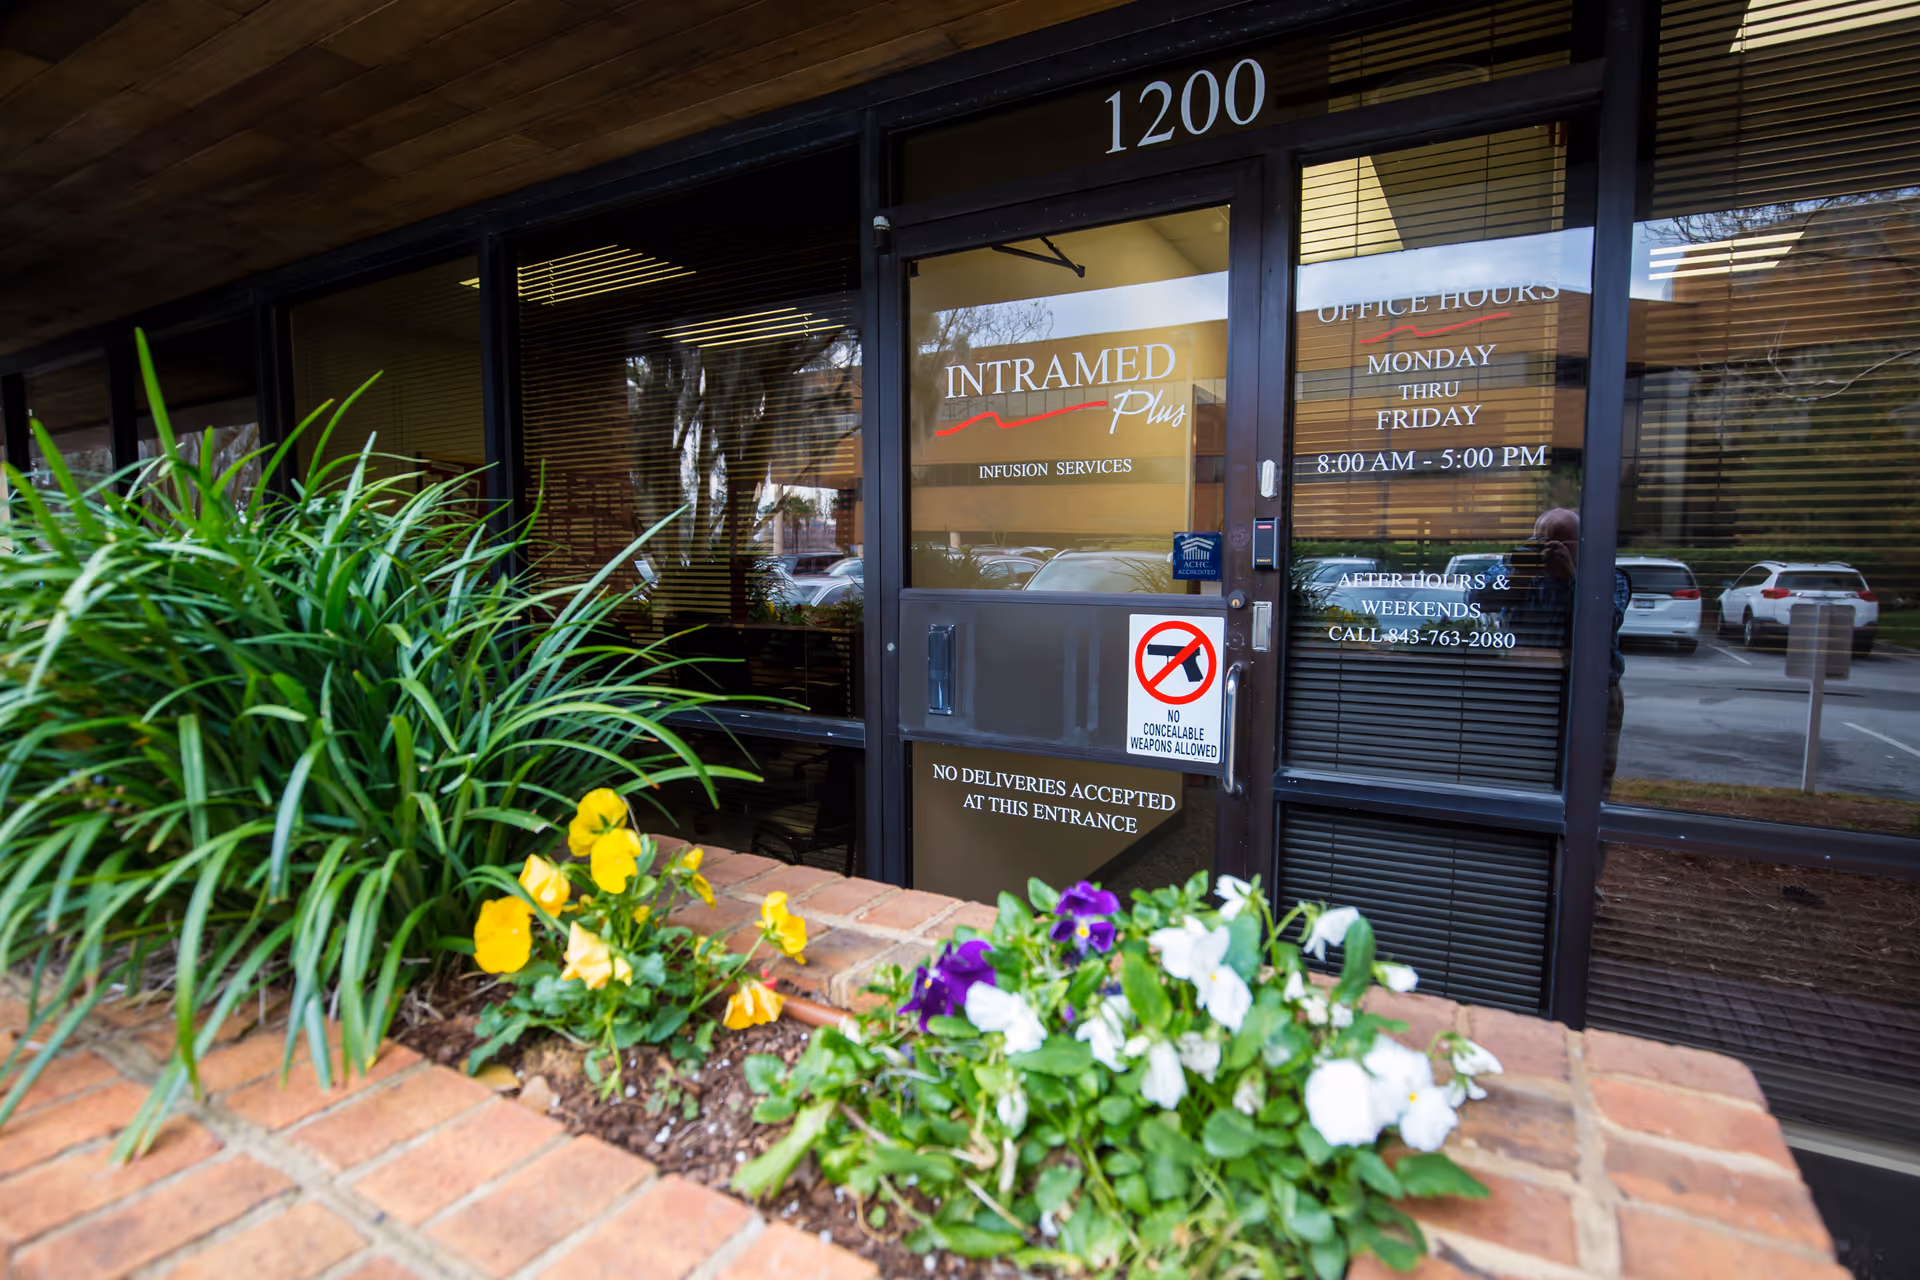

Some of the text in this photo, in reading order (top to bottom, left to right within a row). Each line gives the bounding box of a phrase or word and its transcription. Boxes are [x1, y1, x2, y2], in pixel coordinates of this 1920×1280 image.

[1105, 58, 1266, 154] 1200
[1317, 273, 1561, 323] OFFICE HOURS
[944, 343, 1176, 399] INTRAMED
[1367, 344, 1497, 375] MONDAY
[1398, 381, 1460, 401] THRU
[1109, 388, 1186, 434] Plus
[1375, 405, 1482, 430] FRIDAY
[979, 458, 1133, 479] INFUSION SERVICES
[1317, 452, 1365, 474] 8:00
[1370, 450, 1416, 472] AM
[1440, 447, 1494, 469] 5:00
[1501, 445, 1548, 467] PM
[1338, 572, 1511, 591] AFTER HOURS &
[1361, 600, 1482, 619] WEEKENDS
[1328, 625, 1517, 649] CALL 843-763-2080
[1167, 709, 1180, 723] NO
[1143, 722, 1204, 741] CONCEALABLE
[1130, 736, 1217, 758] WEAPONS ALLOWED
[933, 763, 1176, 811] NO DELIVERIES ACCEPTED
[963, 793, 1138, 834] AT THIS ENTRANCE
